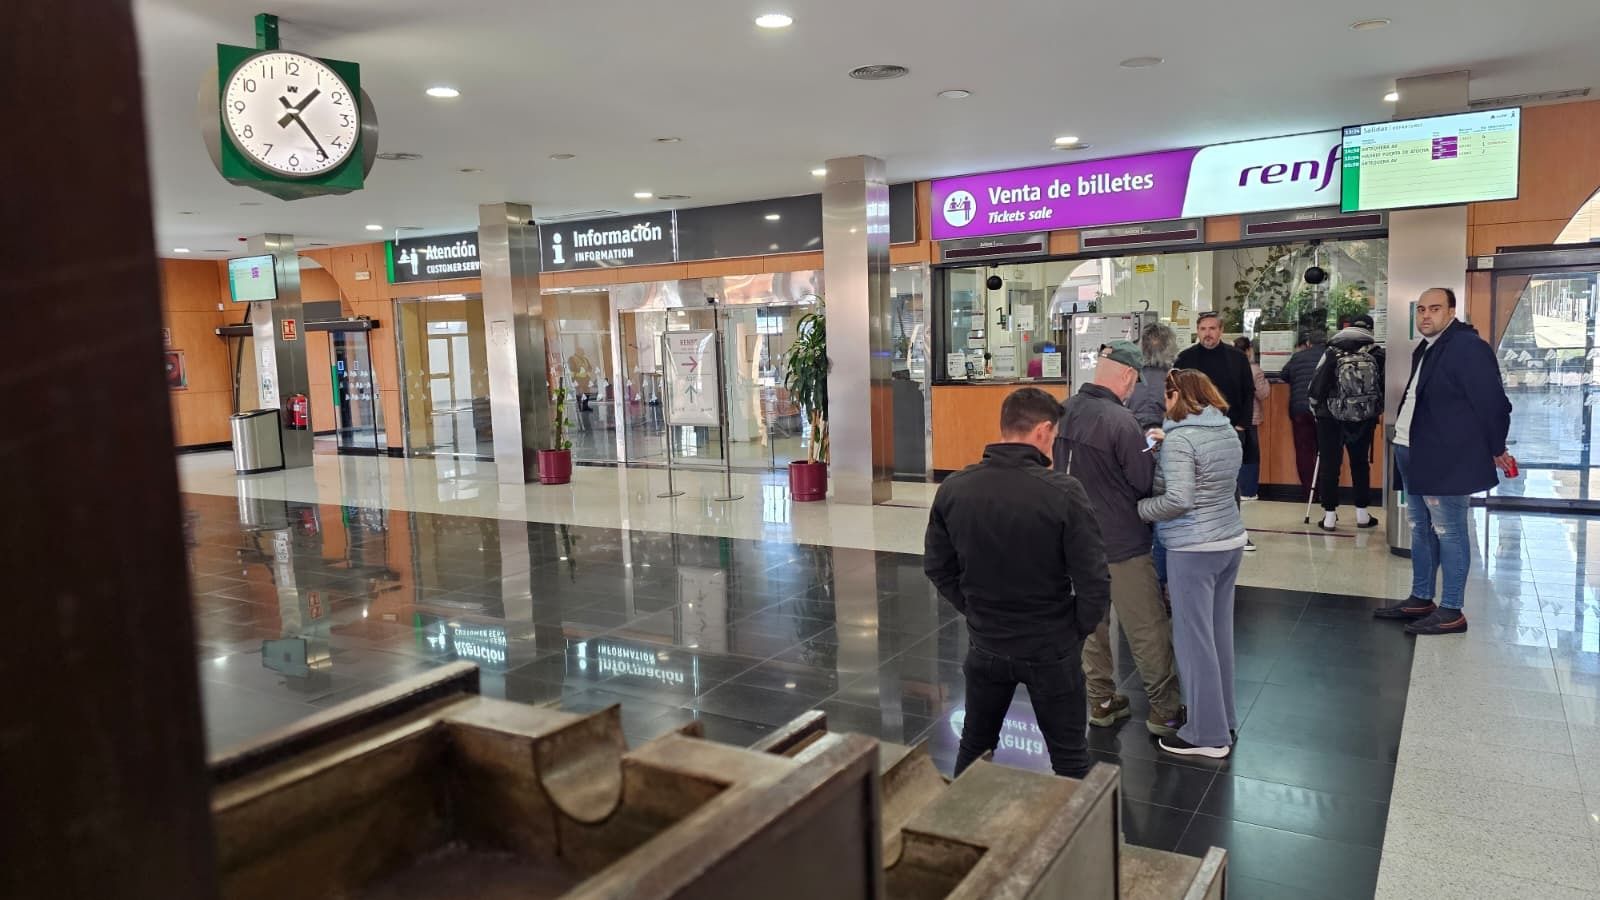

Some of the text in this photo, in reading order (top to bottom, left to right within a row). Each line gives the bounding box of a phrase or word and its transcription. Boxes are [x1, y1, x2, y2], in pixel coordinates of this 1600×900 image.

[262, 65, 274, 80] 11
[285, 61, 300, 77] 12
[243, 79, 257, 93] 10
[316, 71, 322, 86] 1
[331, 91, 343, 105] 2
[234, 100, 246, 115] 9
[339, 113, 350, 128] 3
[243, 124, 254, 139] 8
[331, 135, 342, 149] 4
[263, 143, 273, 157] 7
[315, 148, 327, 163] 5
[288, 153, 300, 167] 6
[1237, 143, 1342, 193] renf
[988, 170, 1155, 206] Venta de billetes
[987, 205, 1053, 224] Tickets sale
[573, 224, 662, 248] Información
[425, 240, 477, 261] Atención
[575, 247, 634, 262] INFORMATION
[426, 262, 462, 275] CUSTOMER
